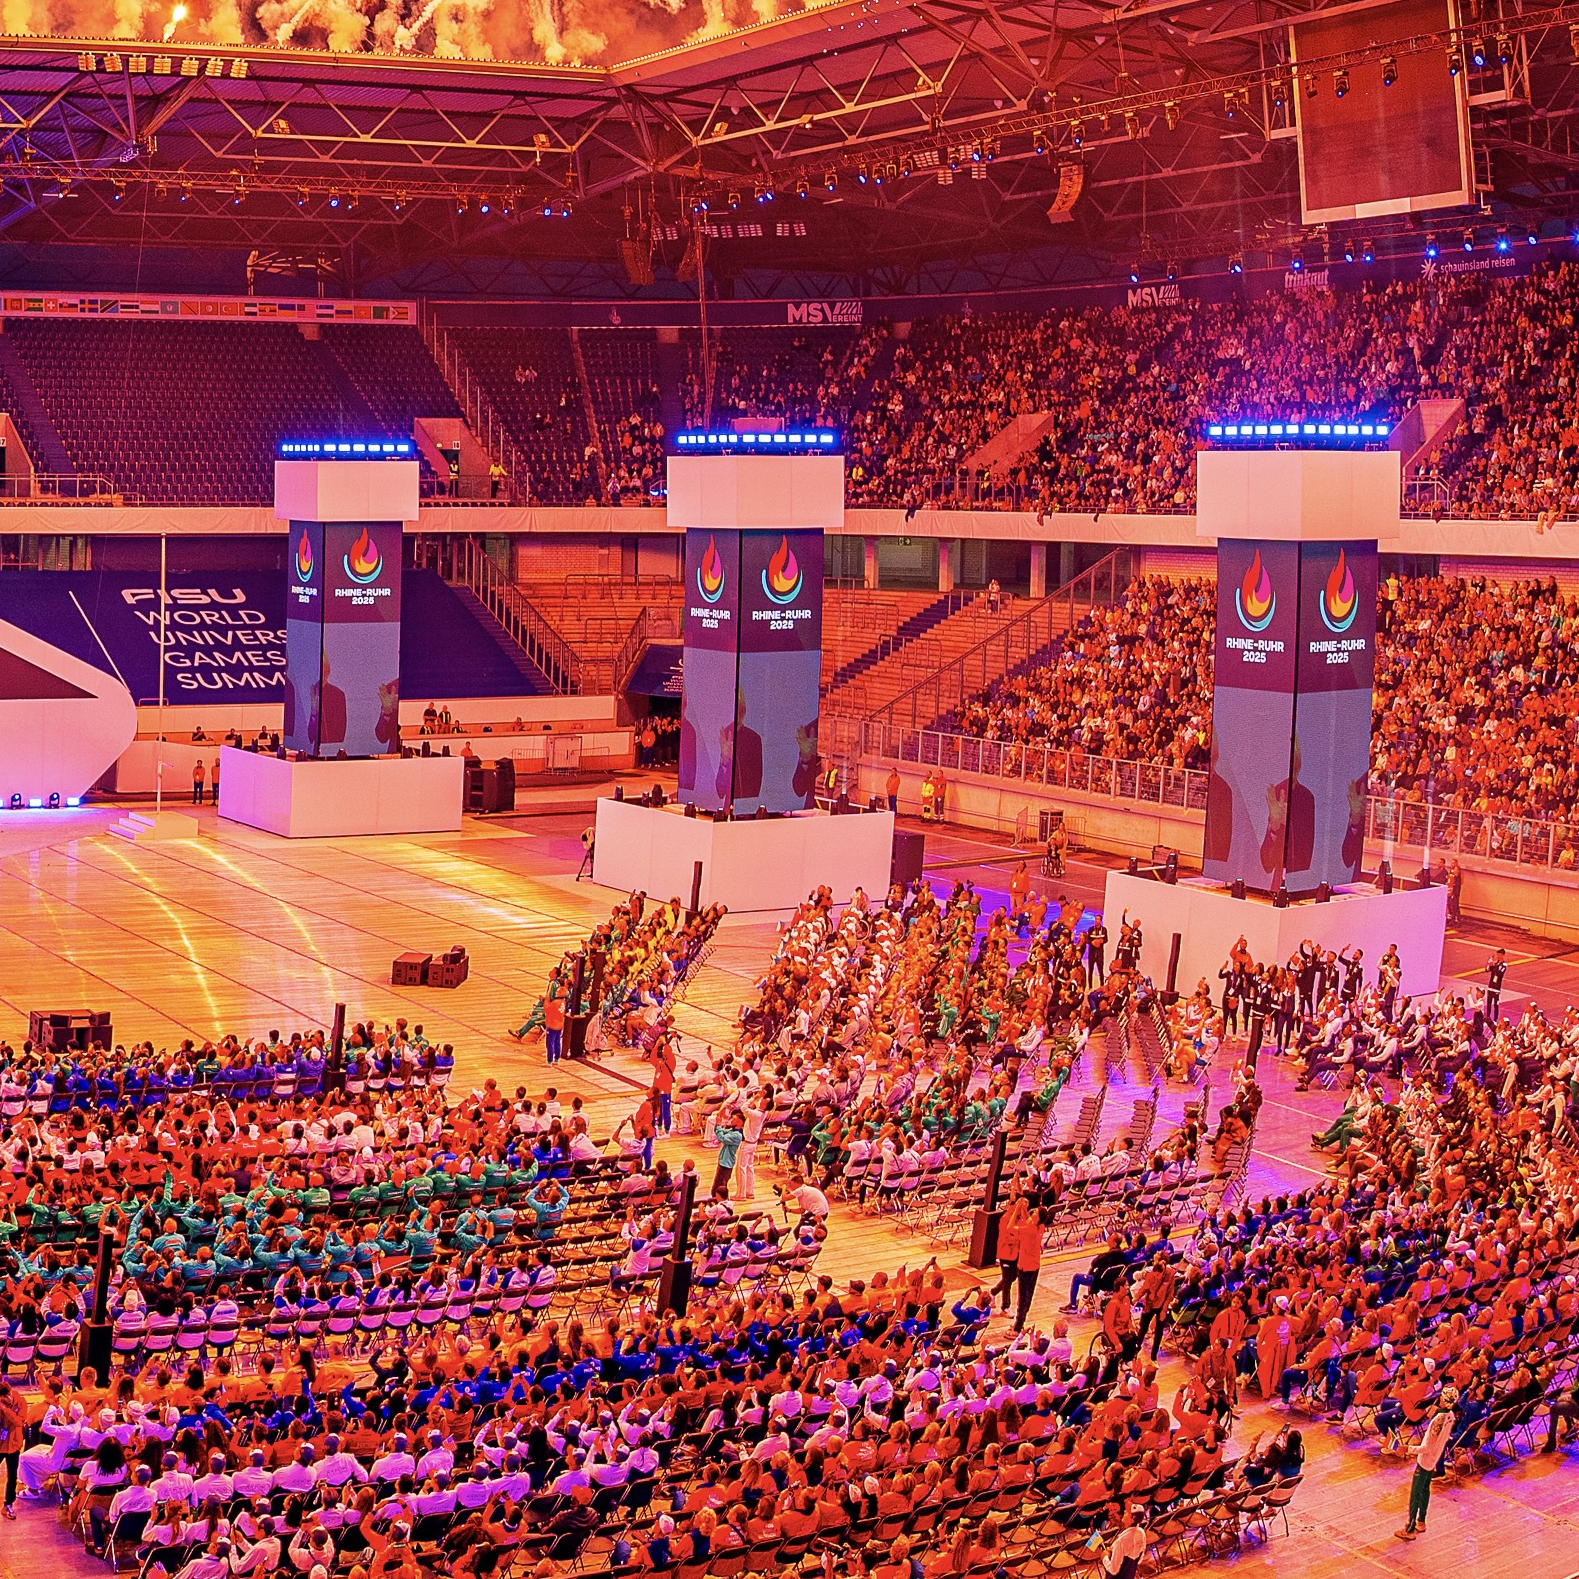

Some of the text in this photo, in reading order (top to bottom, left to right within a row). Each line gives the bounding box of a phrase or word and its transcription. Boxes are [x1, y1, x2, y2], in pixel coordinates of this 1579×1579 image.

[1440, 256, 1515, 273] schauinsland reisen
[787, 302, 842, 323] MSV
[121, 588, 246, 604] FISU
[335, 588, 391, 597] RHINE-RUHR
[352, 597, 375, 605] 2025
[133, 610, 265, 625] WORLD
[690, 607, 730, 620] RHINE-RUHR
[752, 609, 811, 620] RHINE-RUHR
[702, 619, 718, 628] 2025
[770, 620, 794, 630] 2025
[148, 629, 287, 646] UNIVERS
[1226, 637, 1284, 652] RHINE-RUHR
[1309, 639, 1365, 652] RHINE-RUHR
[163, 651, 287, 667] GAMES
[1243, 651, 1266, 663] 2025
[1326, 652, 1349, 664] 2025
[176, 672, 286, 689] SUMM
